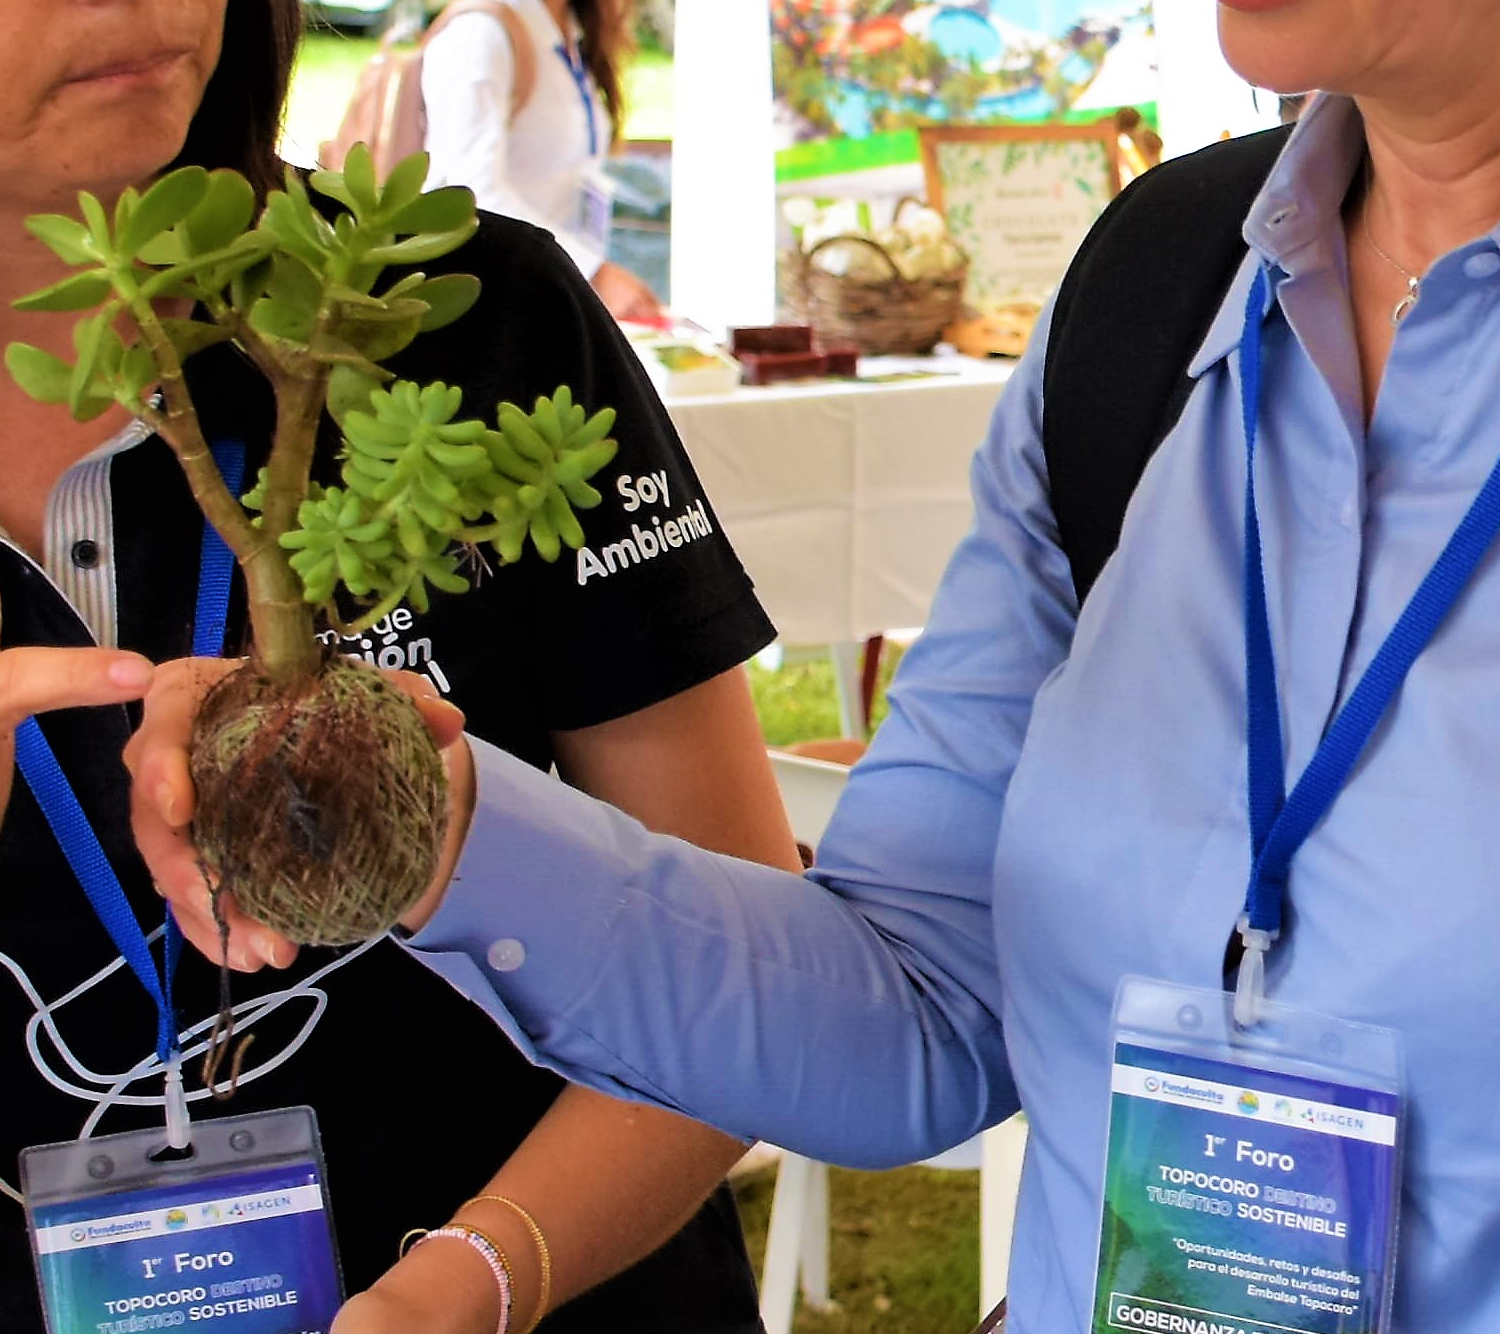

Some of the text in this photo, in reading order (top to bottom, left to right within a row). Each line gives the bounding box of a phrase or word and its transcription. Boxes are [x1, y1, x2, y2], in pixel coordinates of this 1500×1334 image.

[616, 470, 670, 512] Soy
[1315, 1111, 1364, 1130] ISAGEN
[1235, 1139, 1295, 1172] Foro
[243, 1195, 292, 1212] ISAGEN
[1158, 1165, 1336, 1214] TOPOCORO DESTINO
[1146, 1184, 1347, 1238] TURÍSTICO SOSTENIBLE
[174, 1250, 235, 1274] Foro
[1268, 1259, 1300, 1273] retos
[1302, 1265, 1309, 1276] y
[104, 1273, 284, 1315] TOPOCORO DESTINO
[1188, 1258, 1217, 1272] para
[1218, 1263, 1229, 1275] el
[1231, 1265, 1289, 1286] desarrollo
[1341, 1287, 1360, 1300] del
[1247, 1284, 1298, 1304] Embalse
[189, 1290, 298, 1321] SOSTENIBLE
